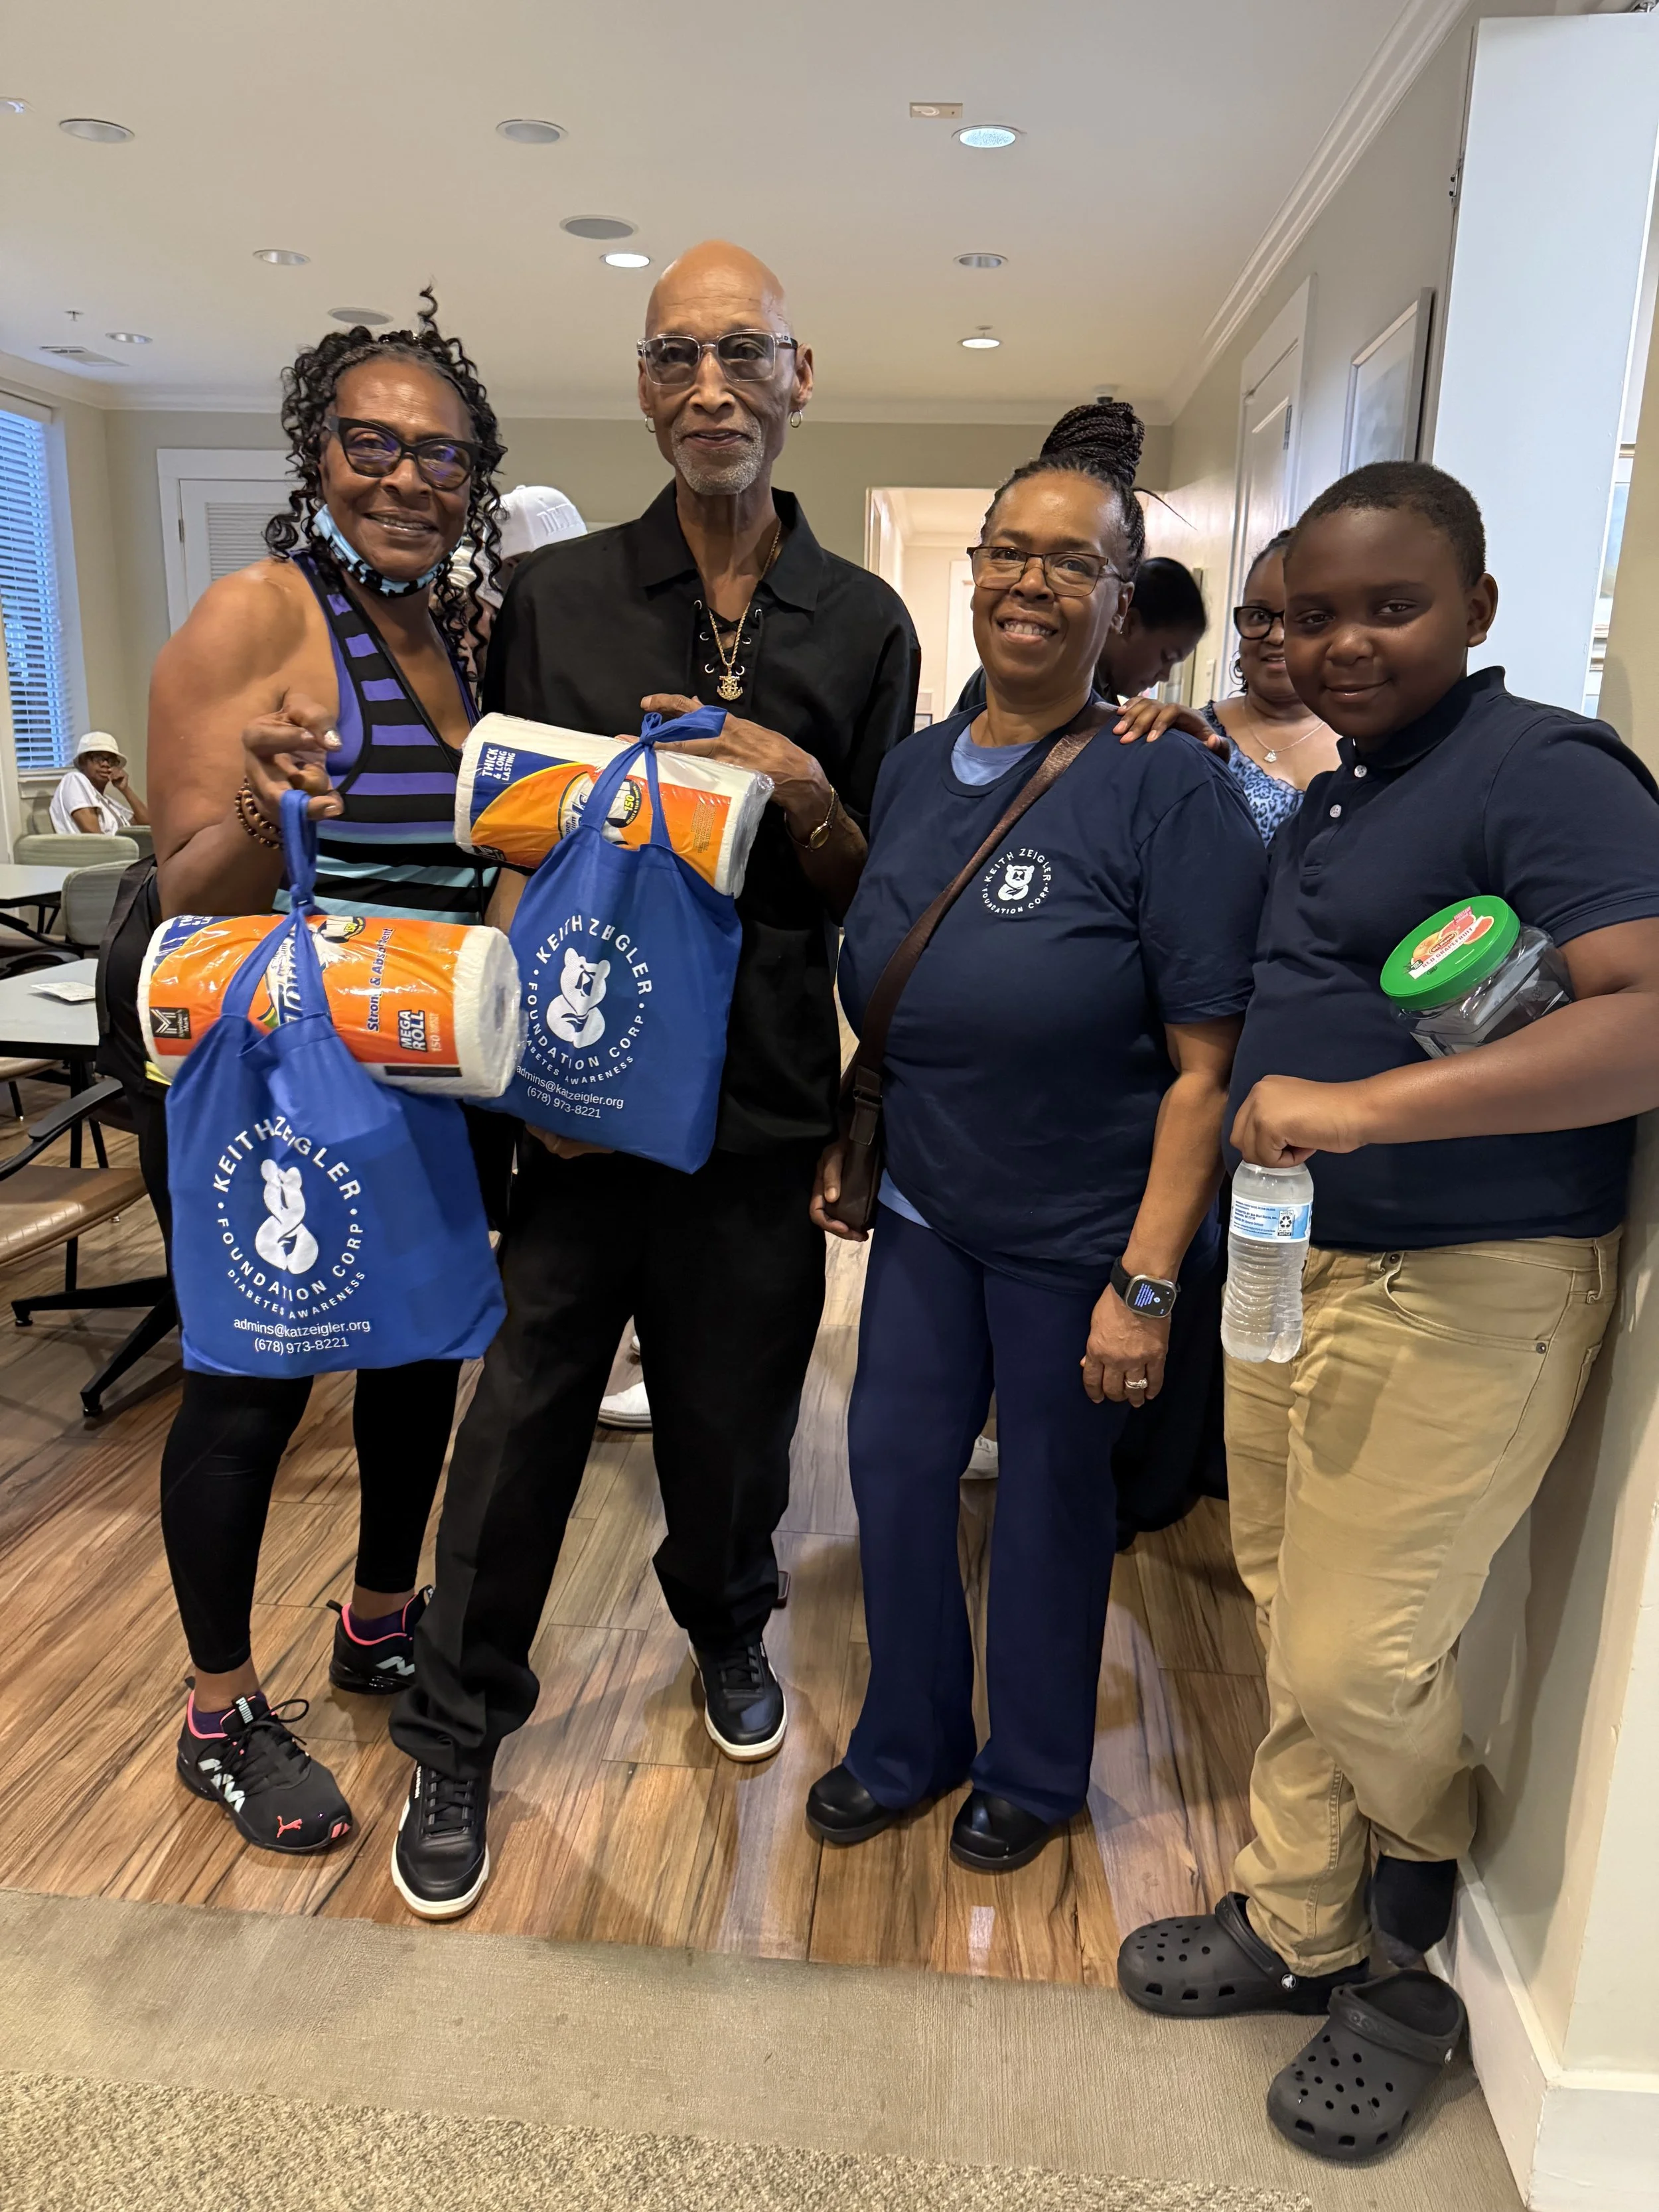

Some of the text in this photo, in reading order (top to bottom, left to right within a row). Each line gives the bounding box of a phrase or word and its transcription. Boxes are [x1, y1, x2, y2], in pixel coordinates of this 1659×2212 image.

[482, 748, 499, 776] THICK
[494, 751, 508, 771] LONG
[502, 752, 516, 781] LASTING
[624, 794, 635, 811] 150
[984, 848, 1051, 882] KEITH ZEIGLER
[1028, 887, 1049, 909] CORP
[344, 922, 358, 933] 150
[536, 915, 583, 964] KEITH
[1422, 957, 1435, 968] RED
[1436, 928, 1473, 958] GRAPEFRUIT
[370, 977, 381, 986] &
[399, 1011, 412, 1049] MEGA
[411, 1009, 427, 1051] ROLL
[528, 982, 644, 1070] FOUNDATION CORP
[565, 1056, 634, 1085] AWARENESS
[516, 1065, 624, 1109] admins@katzeigler.org
[527, 1085, 602, 1119] (678) 973-8221
[213, 1119, 275, 1193] KEITH
[218, 1217, 364, 1302] FOUNDATION CORP
[228, 1269, 366, 1319] DIABETES AWARENESS
[234, 1317, 371, 1339] admins@katzeigler.org
[254, 1336, 350, 1357] (678) 973-8221
[236, 1697, 253, 1724] PUMA
